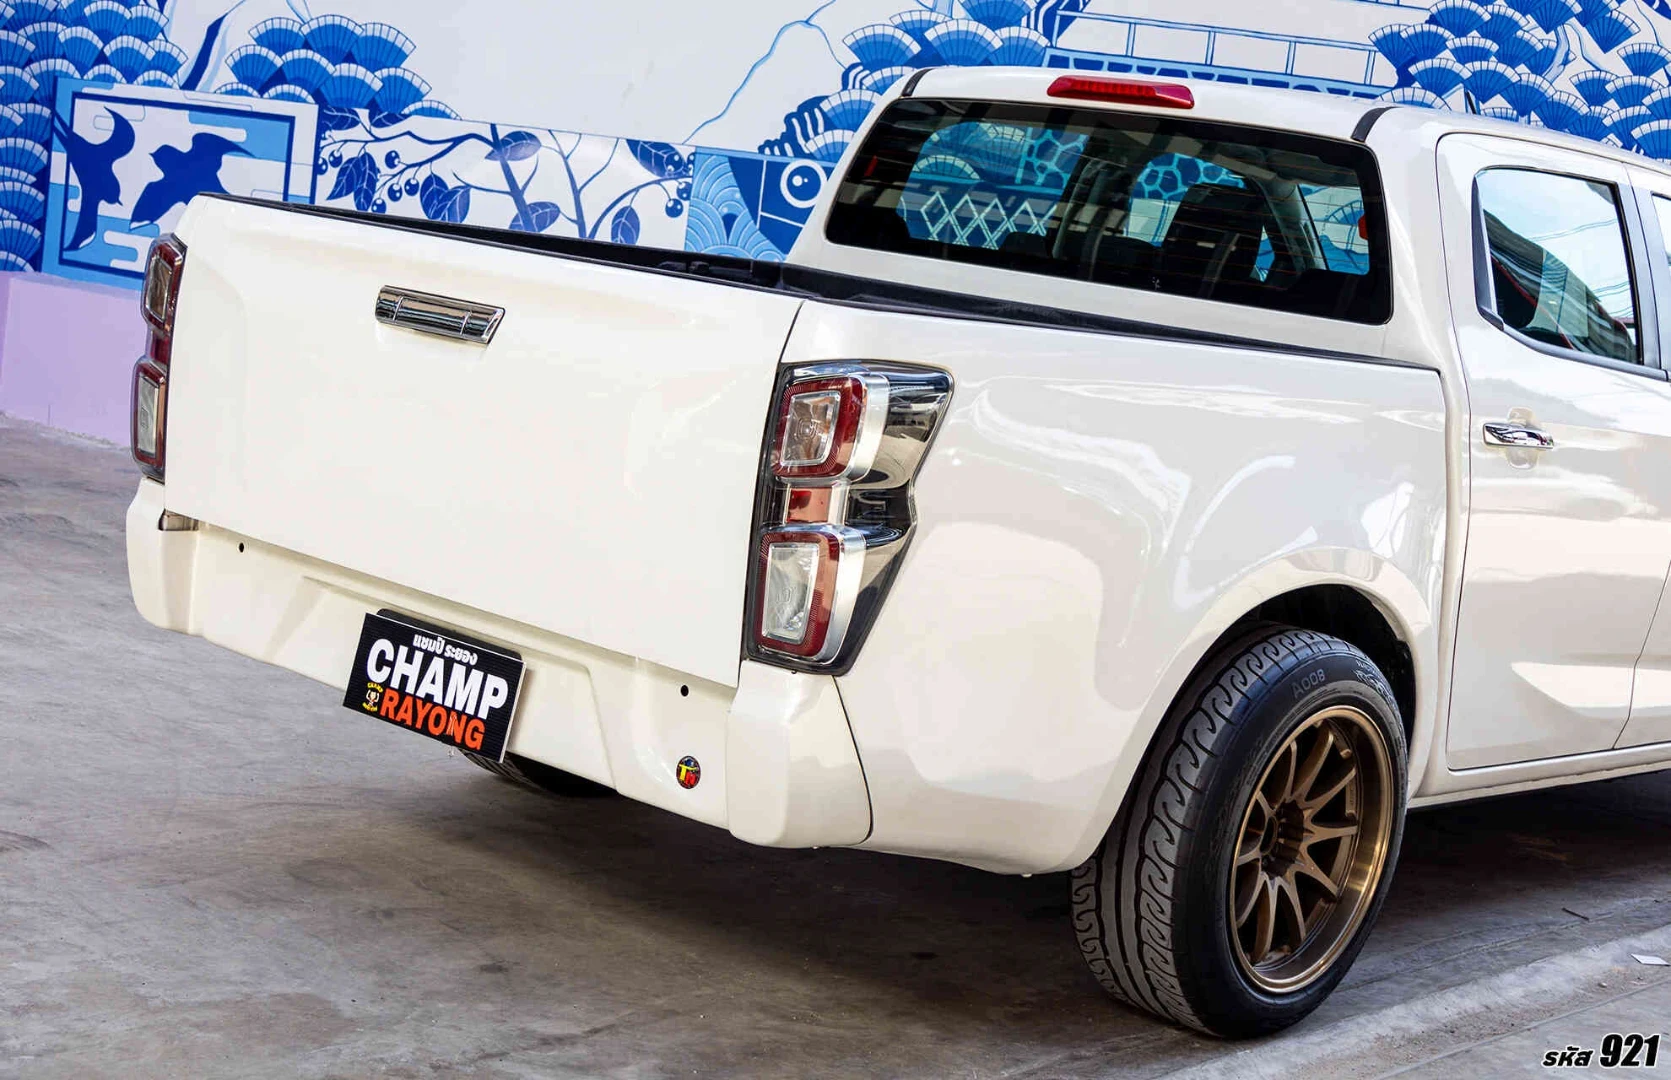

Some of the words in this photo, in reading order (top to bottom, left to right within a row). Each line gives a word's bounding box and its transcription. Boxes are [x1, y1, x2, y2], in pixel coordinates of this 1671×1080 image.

[444, 644, 478, 666] ระยอง
[366, 638, 509, 720] CHAMP
[1291, 668, 1327, 699] A008
[379, 687, 486, 751] RAYONG
